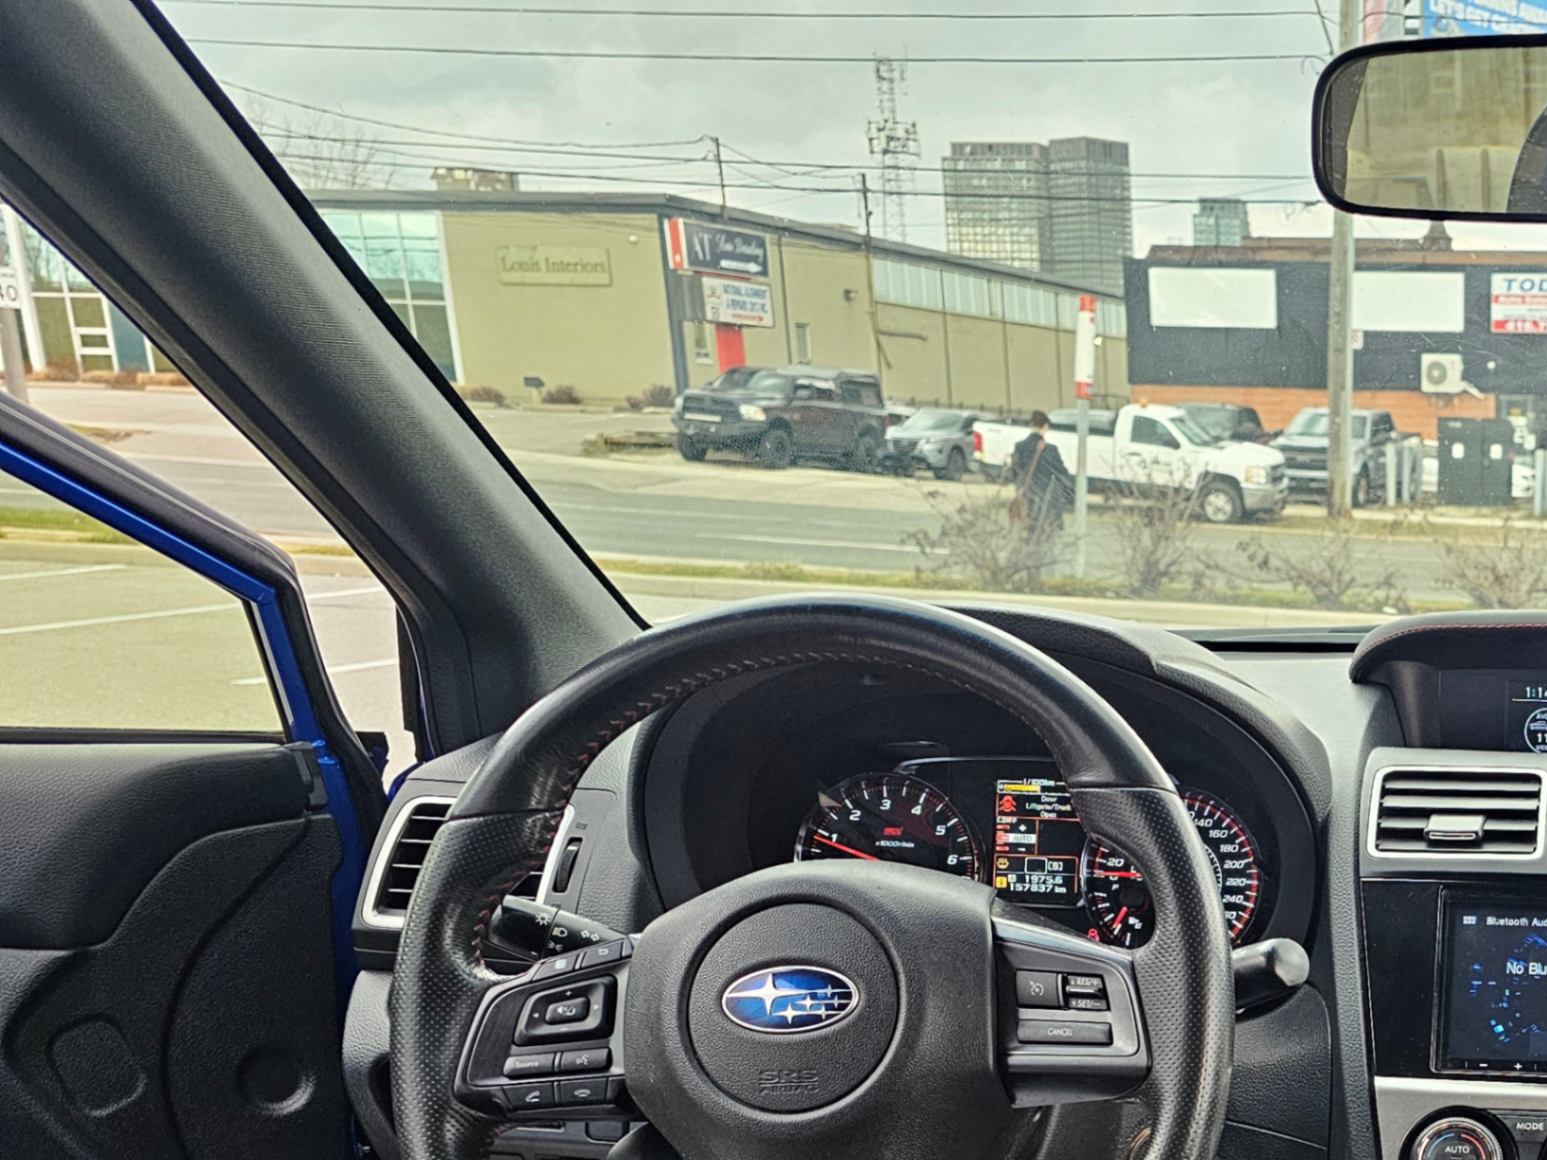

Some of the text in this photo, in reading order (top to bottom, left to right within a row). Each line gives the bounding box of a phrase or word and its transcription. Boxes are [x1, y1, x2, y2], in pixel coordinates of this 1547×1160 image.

[880, 800, 890, 810] 3
[911, 805, 921, 815] 4
[849, 810, 861, 820] 2
[935, 826, 946, 835] 5
[1209, 829, 1228, 838] 160
[947, 855, 958, 865] 6
[1107, 858, 1125, 867] 20
[1224, 860, 1245, 869] 200
[1025, 874, 1063, 884] 1975.6
[1226, 878, 1246, 887] 220
[1010, 883, 1053, 892] 157837
[1223, 895, 1244, 903] 240
[1486, 917, 1528, 927] Bluetooth
[1506, 961, 1524, 976] No
[1047, 1028, 1073, 1037] CANCEL
[759, 1069, 819, 1083] SRS
[1516, 1122, 1544, 1131] MODE
[1445, 1145, 1469, 1154] AUTO
